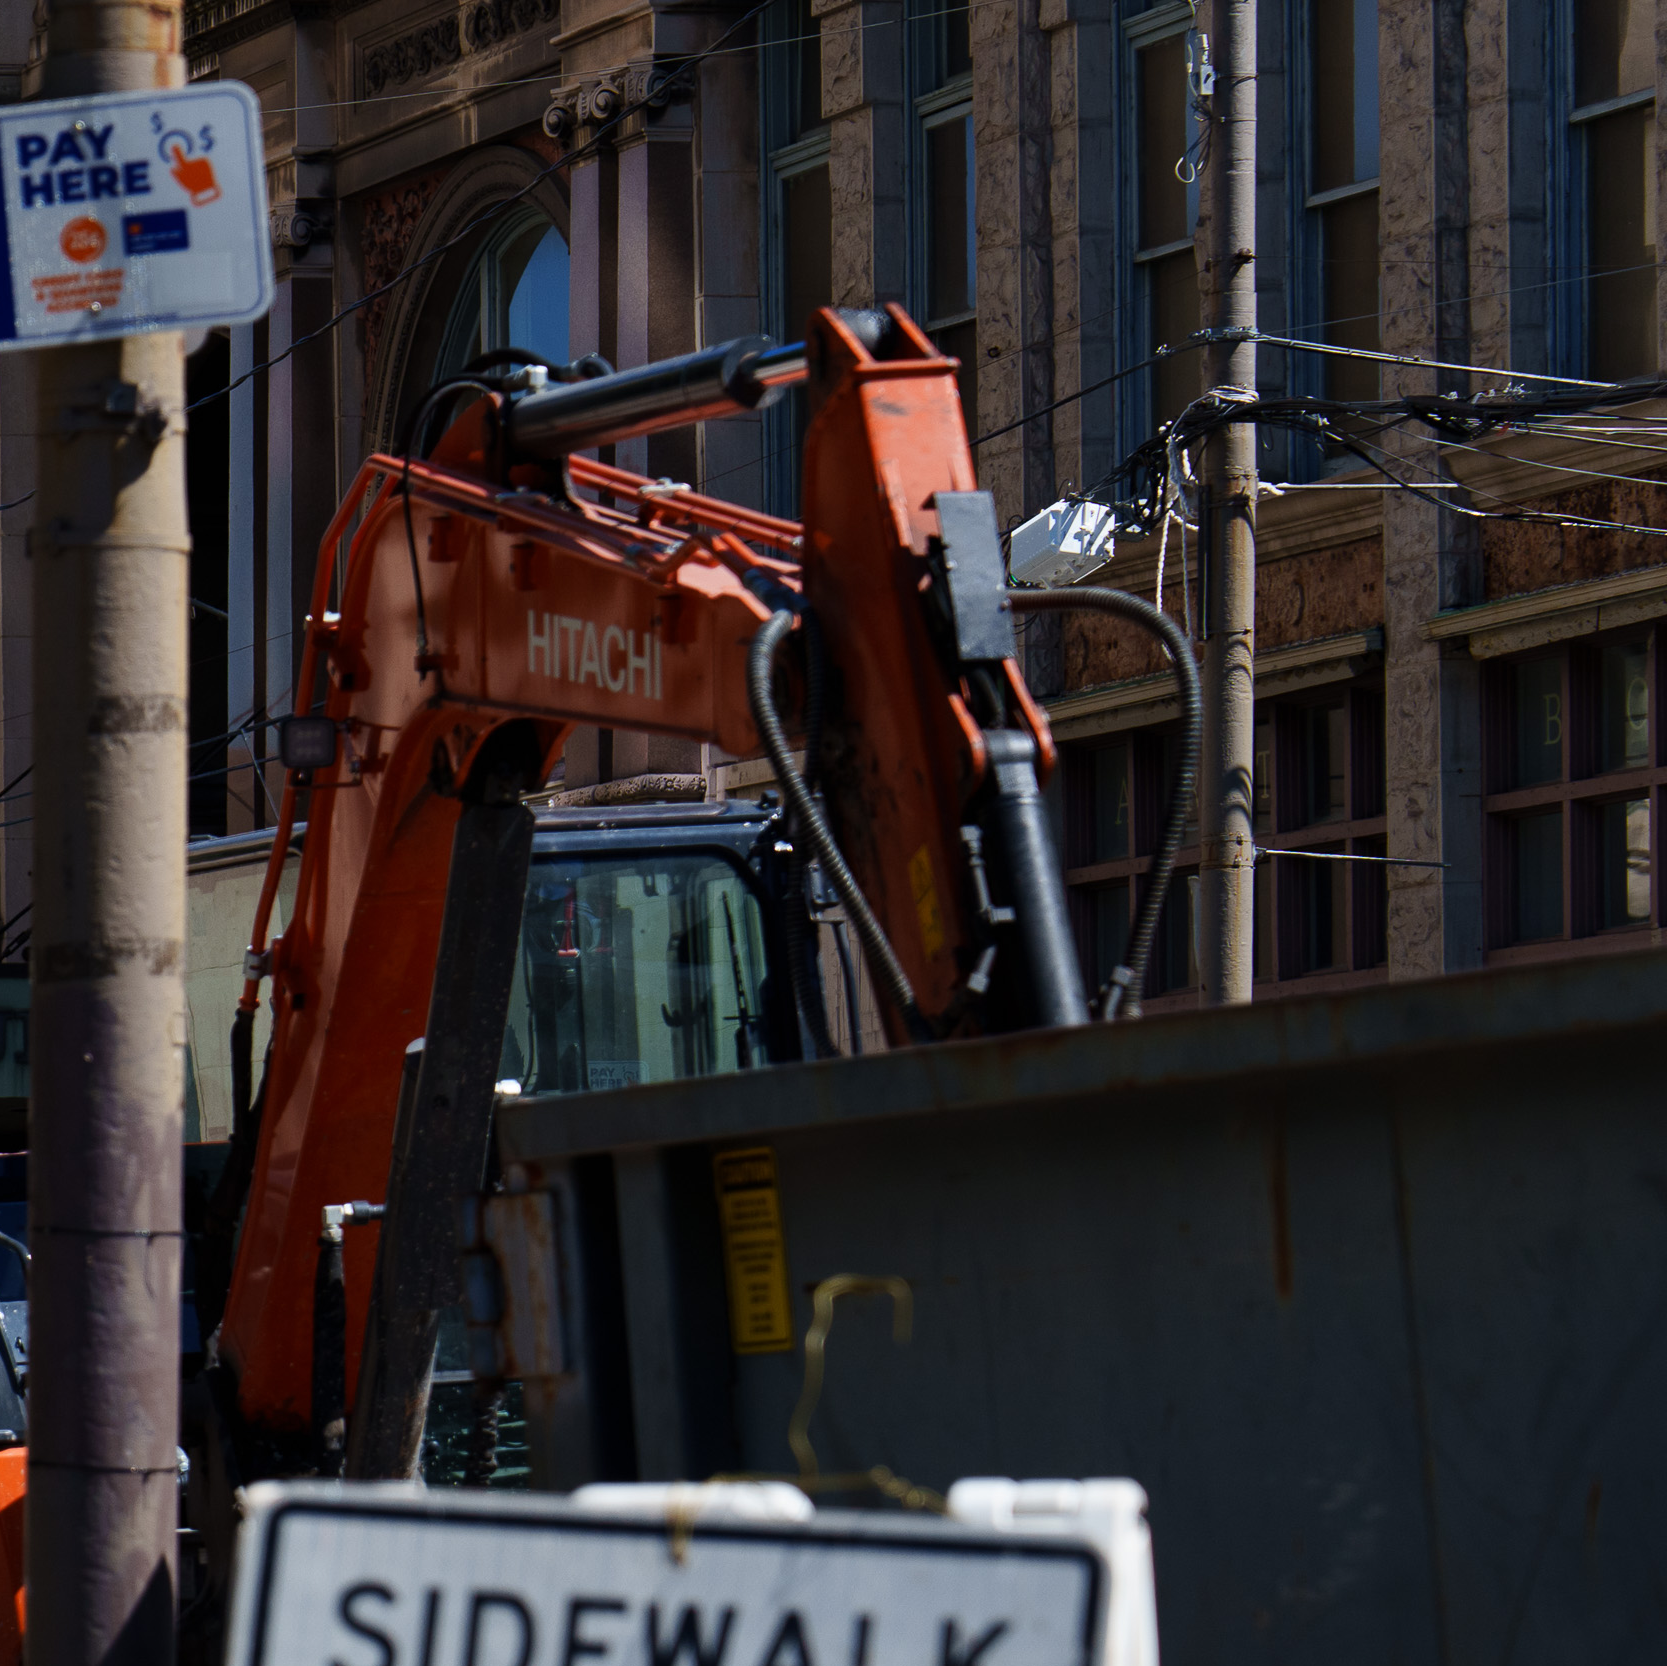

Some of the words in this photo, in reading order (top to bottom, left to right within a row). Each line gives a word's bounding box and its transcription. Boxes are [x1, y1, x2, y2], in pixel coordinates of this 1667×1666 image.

[16, 125, 114, 170] PAY
[20, 160, 153, 210] HERE
[527, 608, 663, 701] HITACHI
[590, 1067, 615, 1078] PAY
